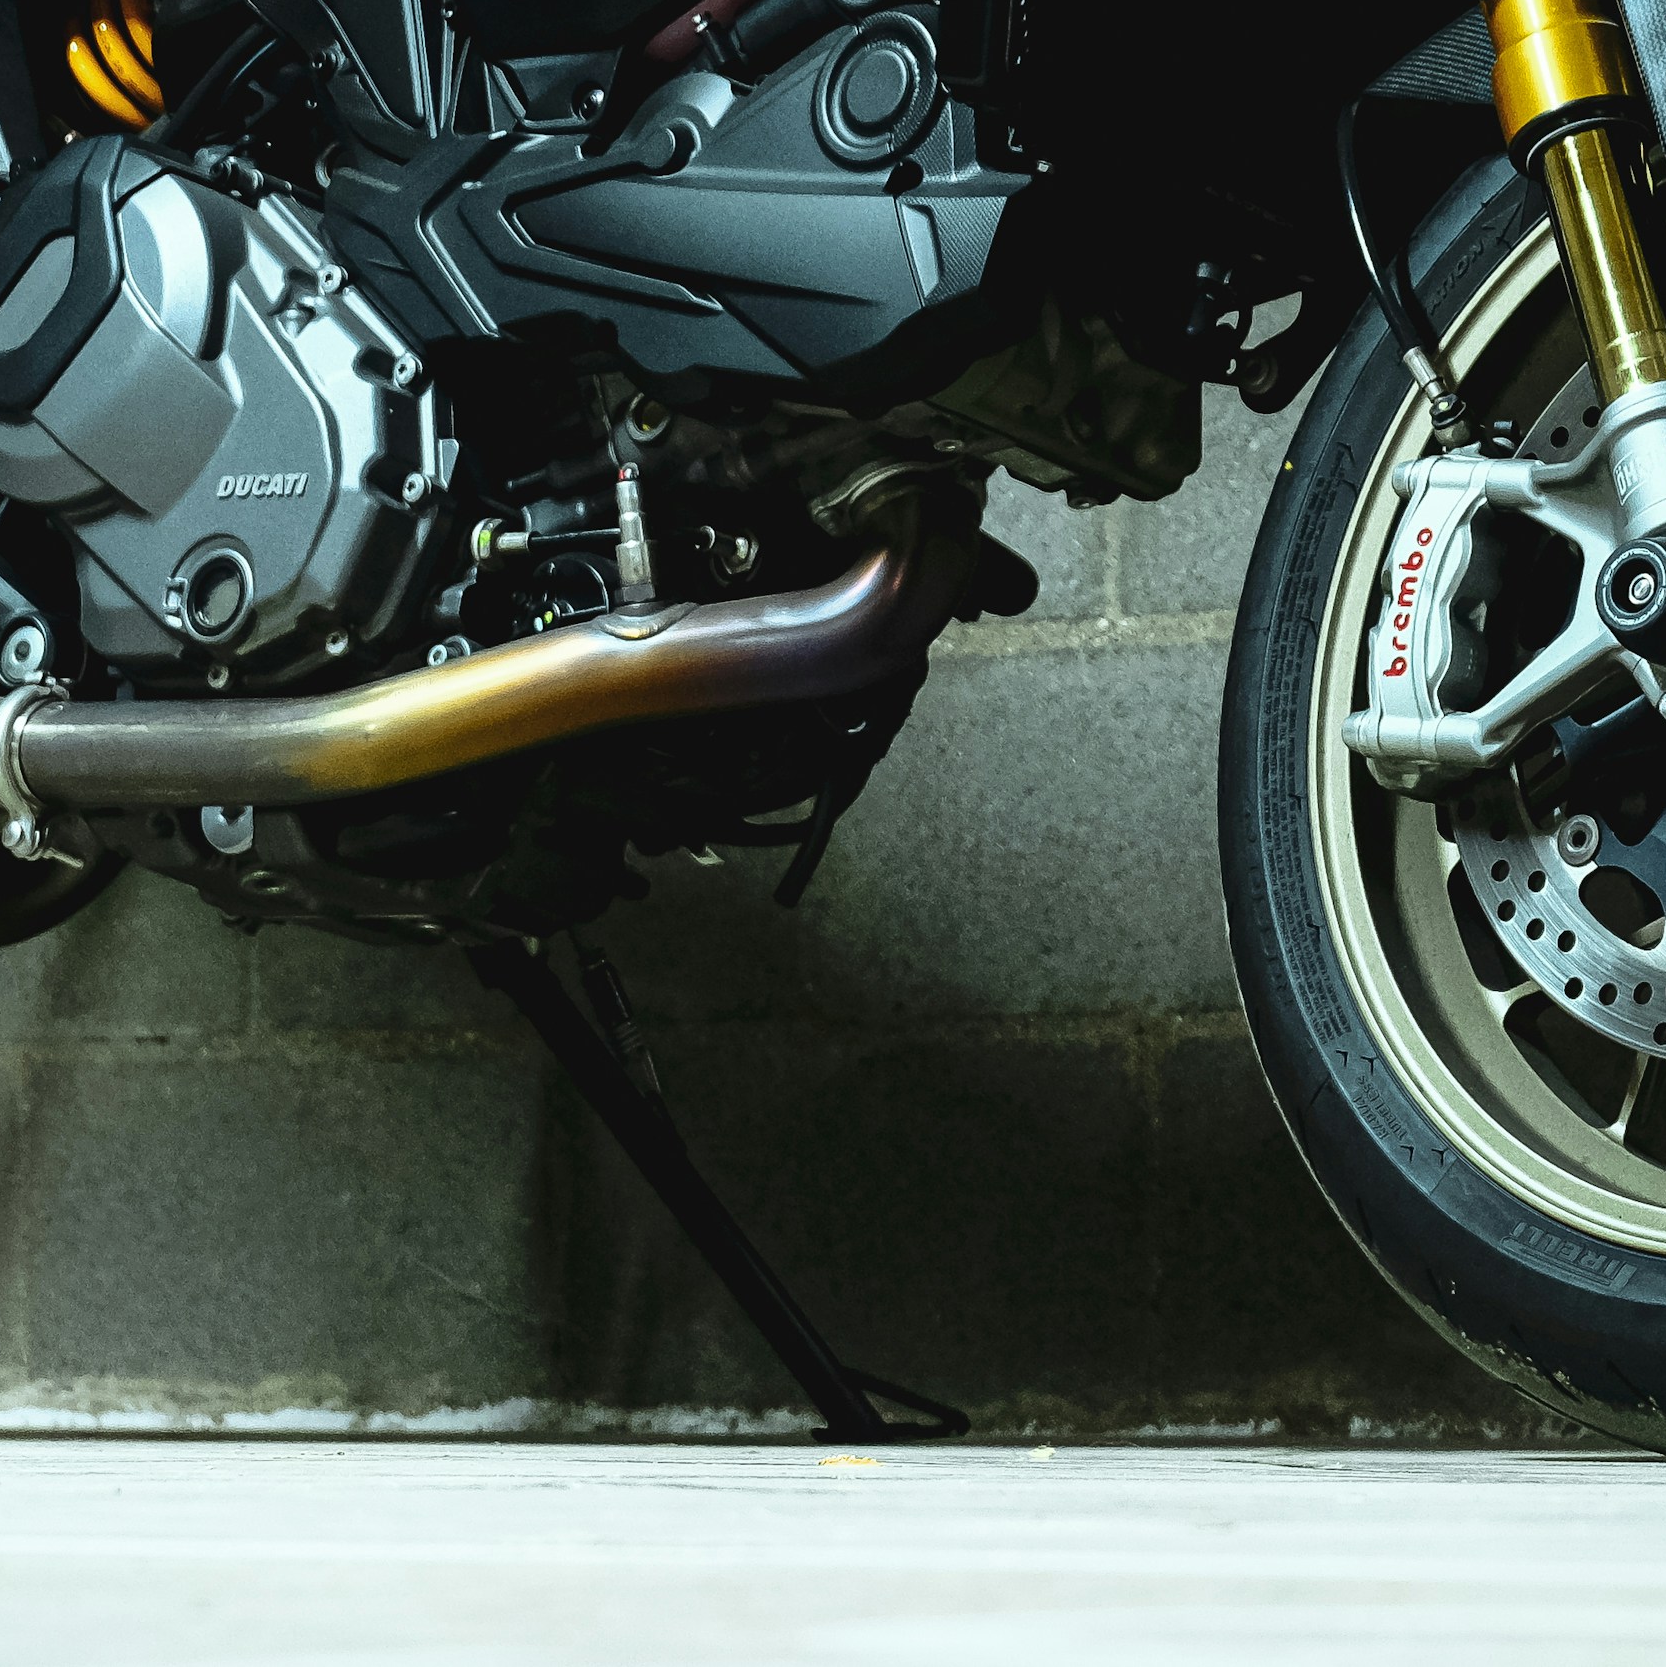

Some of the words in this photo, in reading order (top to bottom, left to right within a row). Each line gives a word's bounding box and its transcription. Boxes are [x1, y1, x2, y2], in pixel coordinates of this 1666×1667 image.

[217, 472, 309, 499] DUCATI
[1383, 527, 1434, 677] brembo
[1504, 1220, 1637, 1292] PIRELLI
